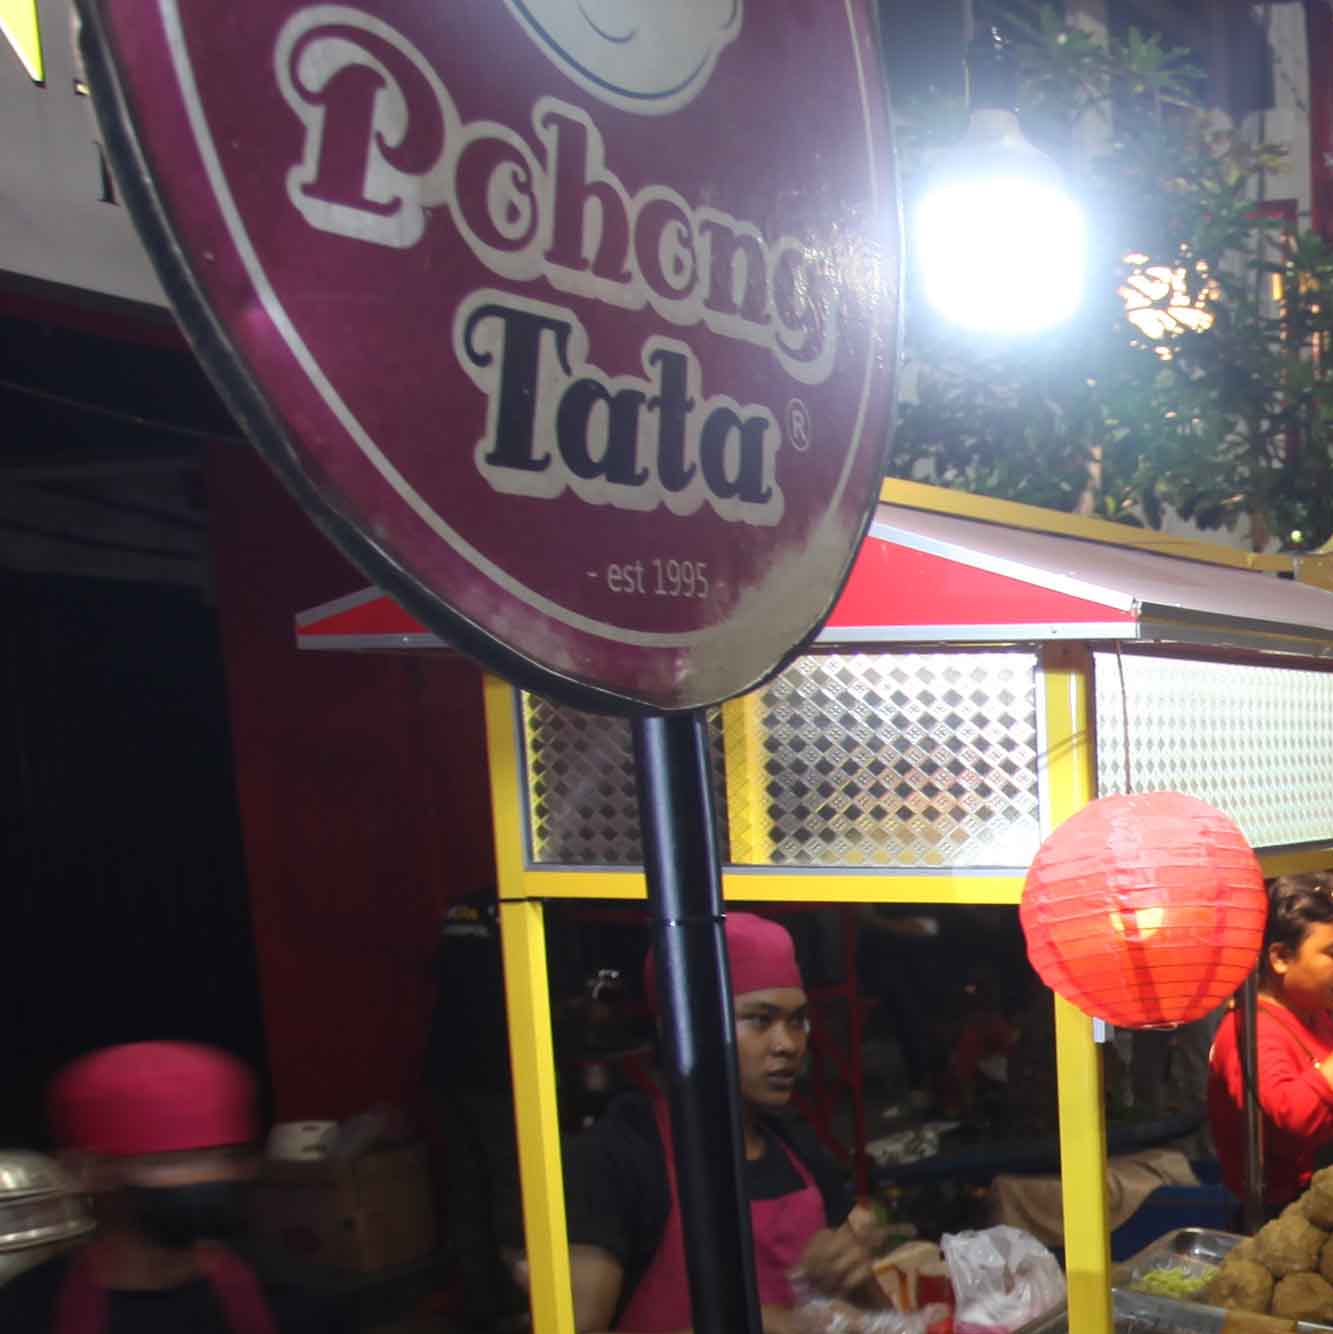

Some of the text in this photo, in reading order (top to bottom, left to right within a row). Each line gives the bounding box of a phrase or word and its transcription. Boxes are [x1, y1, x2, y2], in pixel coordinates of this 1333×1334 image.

[278, 8, 836, 382] Pohong
[455, 292, 782, 523] Tata
[607, 557, 709, 599] est 1995
